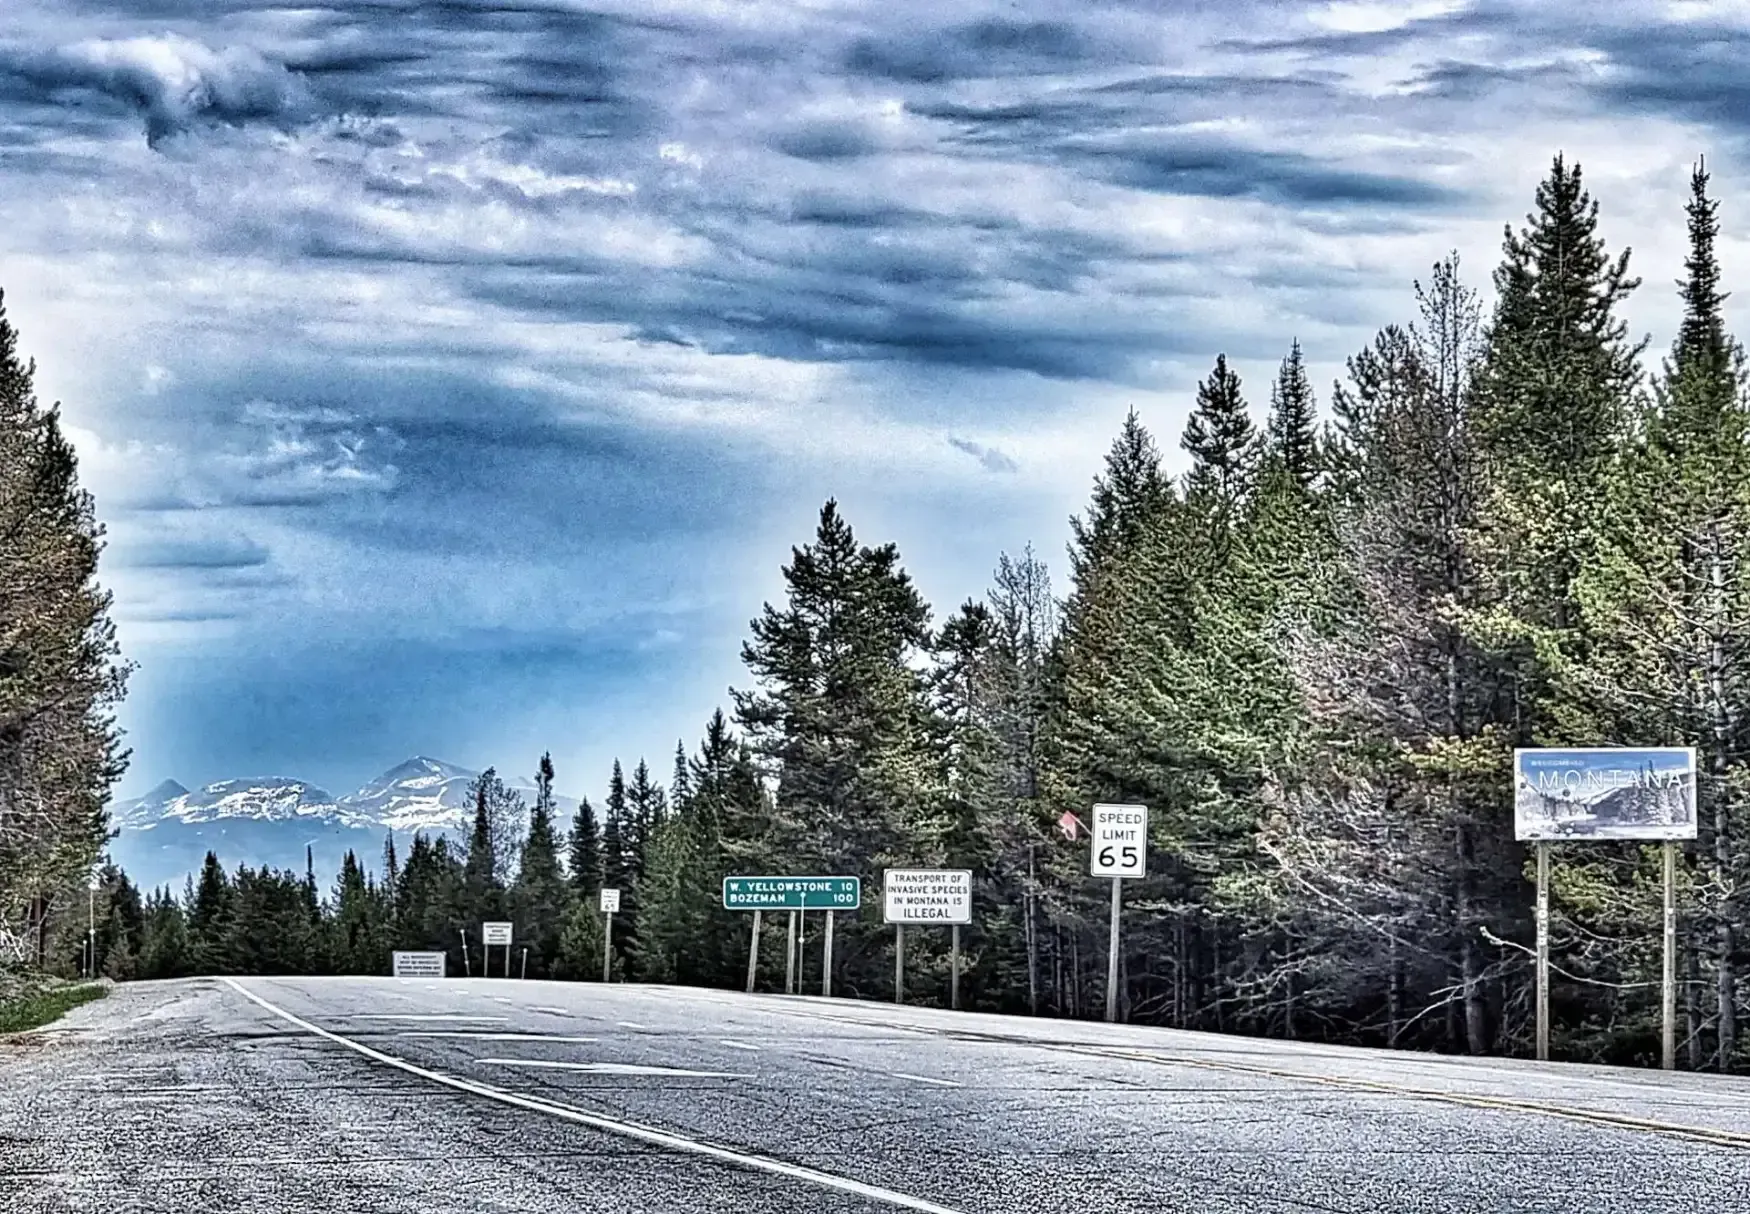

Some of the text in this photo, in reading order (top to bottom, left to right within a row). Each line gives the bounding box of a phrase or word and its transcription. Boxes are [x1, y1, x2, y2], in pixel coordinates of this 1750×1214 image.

[1539, 769, 1683, 789] MONTANA
[1099, 813, 1142, 824] SPEED
[1102, 829, 1136, 841] LIMIT
[1098, 845, 1138, 868] 65
[895, 874, 963, 883] TRANSPORT OF
[730, 882, 853, 891] W. YELLOWSTONE 10
[888, 886, 968, 894] INVASIVE SPECIES
[729, 893, 854, 903] BOZEMAN 100
[894, 897, 962, 905] IN MONTANA IS
[904, 908, 952, 918] ILLEGAL
